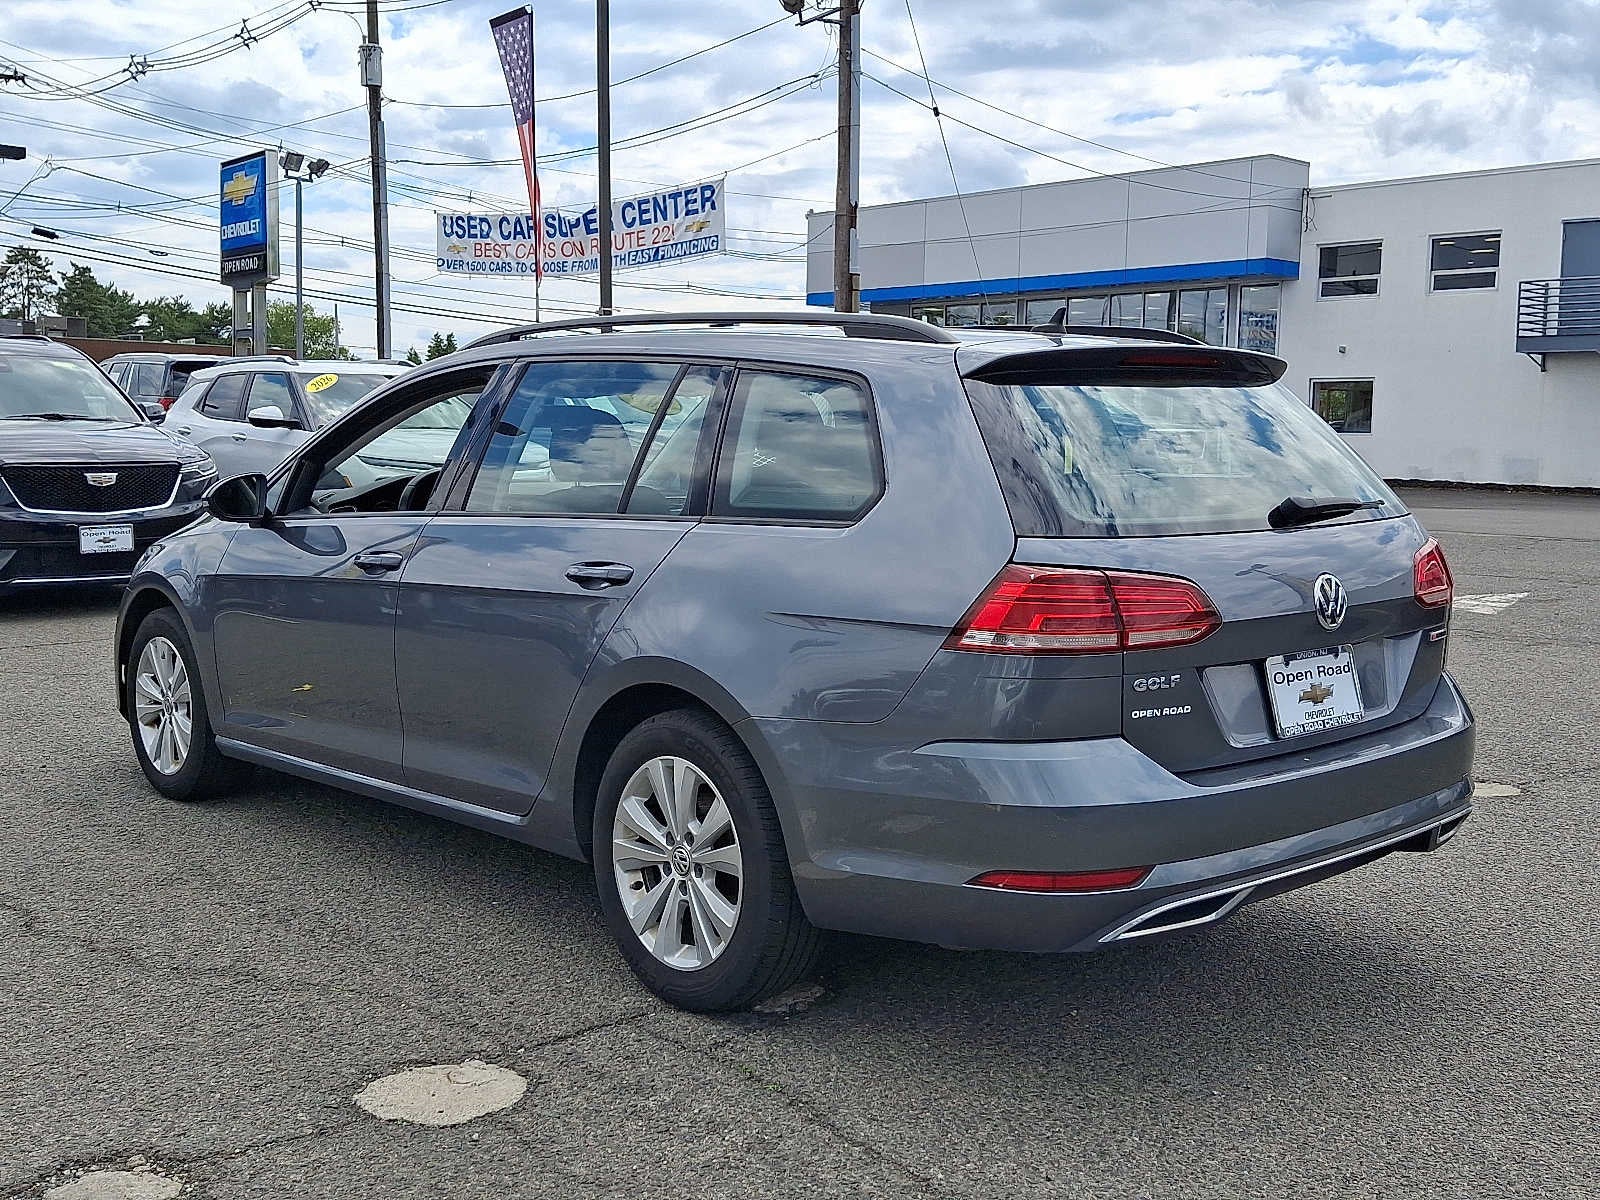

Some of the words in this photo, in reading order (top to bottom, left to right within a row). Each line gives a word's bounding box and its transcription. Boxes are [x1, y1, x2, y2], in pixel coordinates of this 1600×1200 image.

[442, 215, 493, 239] USED
[544, 207, 614, 239] SUPE
[621, 184, 717, 229] CENTER
[221, 218, 261, 240] CHEVROLET
[437, 257, 465, 271] OVER
[465, 260, 487, 272] 1500
[488, 260, 513, 273] CARS
[515, 261, 528, 273] TO
[530, 260, 568, 273] COOSE
[570, 257, 599, 272] FROM
[628, 248, 658, 266] EASY
[658, 236, 718, 260] FINANCING
[473, 242, 512, 259] BEST
[560, 240, 586, 258] ON
[590, 229, 646, 256] RUTE
[224, 260, 240, 273] OPEN
[240, 256, 258, 270] ROAD
[310, 375, 333, 391] 2026
[1133, 674, 1181, 692] GOLF
[1273, 669, 1313, 686] Open
[1316, 661, 1351, 678] Road
[1131, 708, 1161, 719] OPEN
[1162, 705, 1192, 716] ROAD
[1304, 706, 1335, 721] CHEVROLET
[1285, 724, 1304, 737] OPEN
[1304, 720, 1324, 733] ROAD
[1325, 711, 1363, 727] CHEVROLET
